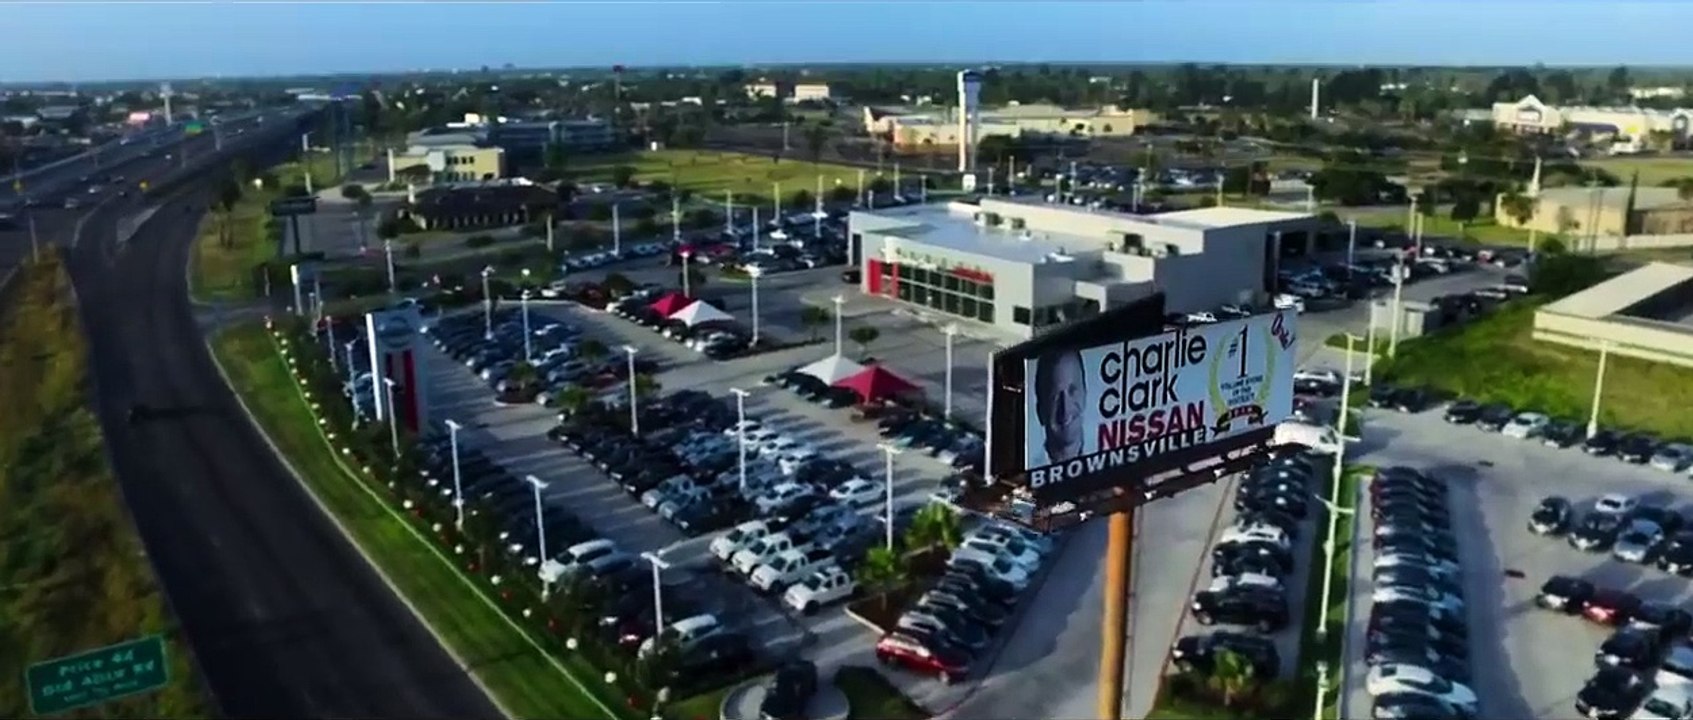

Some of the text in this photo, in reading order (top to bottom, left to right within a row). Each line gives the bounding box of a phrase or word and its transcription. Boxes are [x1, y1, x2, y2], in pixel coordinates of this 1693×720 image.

[1100, 329, 1207, 385] charlie
[1228, 325, 1249, 379] #1
[1098, 367, 1179, 418] clark
[1097, 401, 1205, 451] NISSAN
[1030, 429, 1206, 489] BROWNSVILLE
